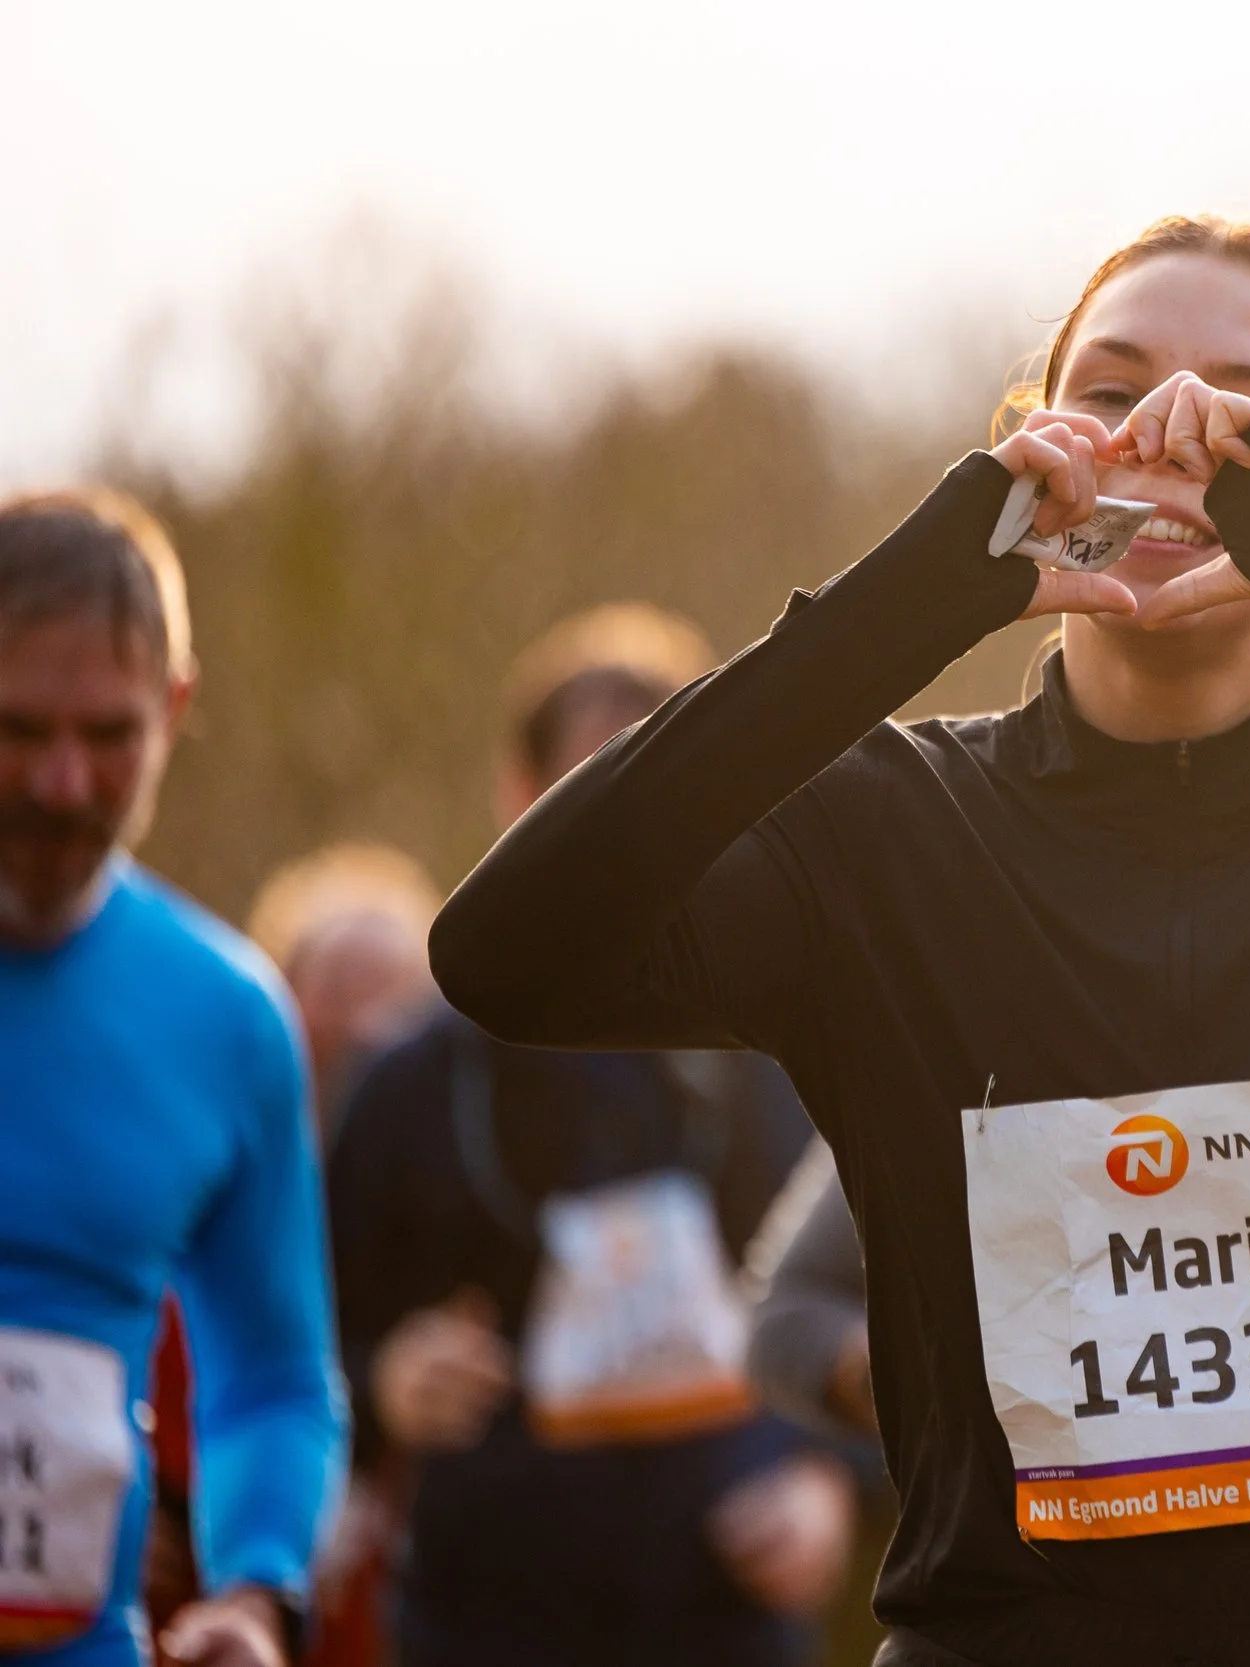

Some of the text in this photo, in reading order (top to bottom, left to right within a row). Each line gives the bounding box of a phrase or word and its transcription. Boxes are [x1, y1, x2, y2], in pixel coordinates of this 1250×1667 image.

[1029, 1498, 1063, 1522] NN
[1069, 1491, 1158, 1524] Egmond
[1165, 1484, 1240, 1511] Halve
